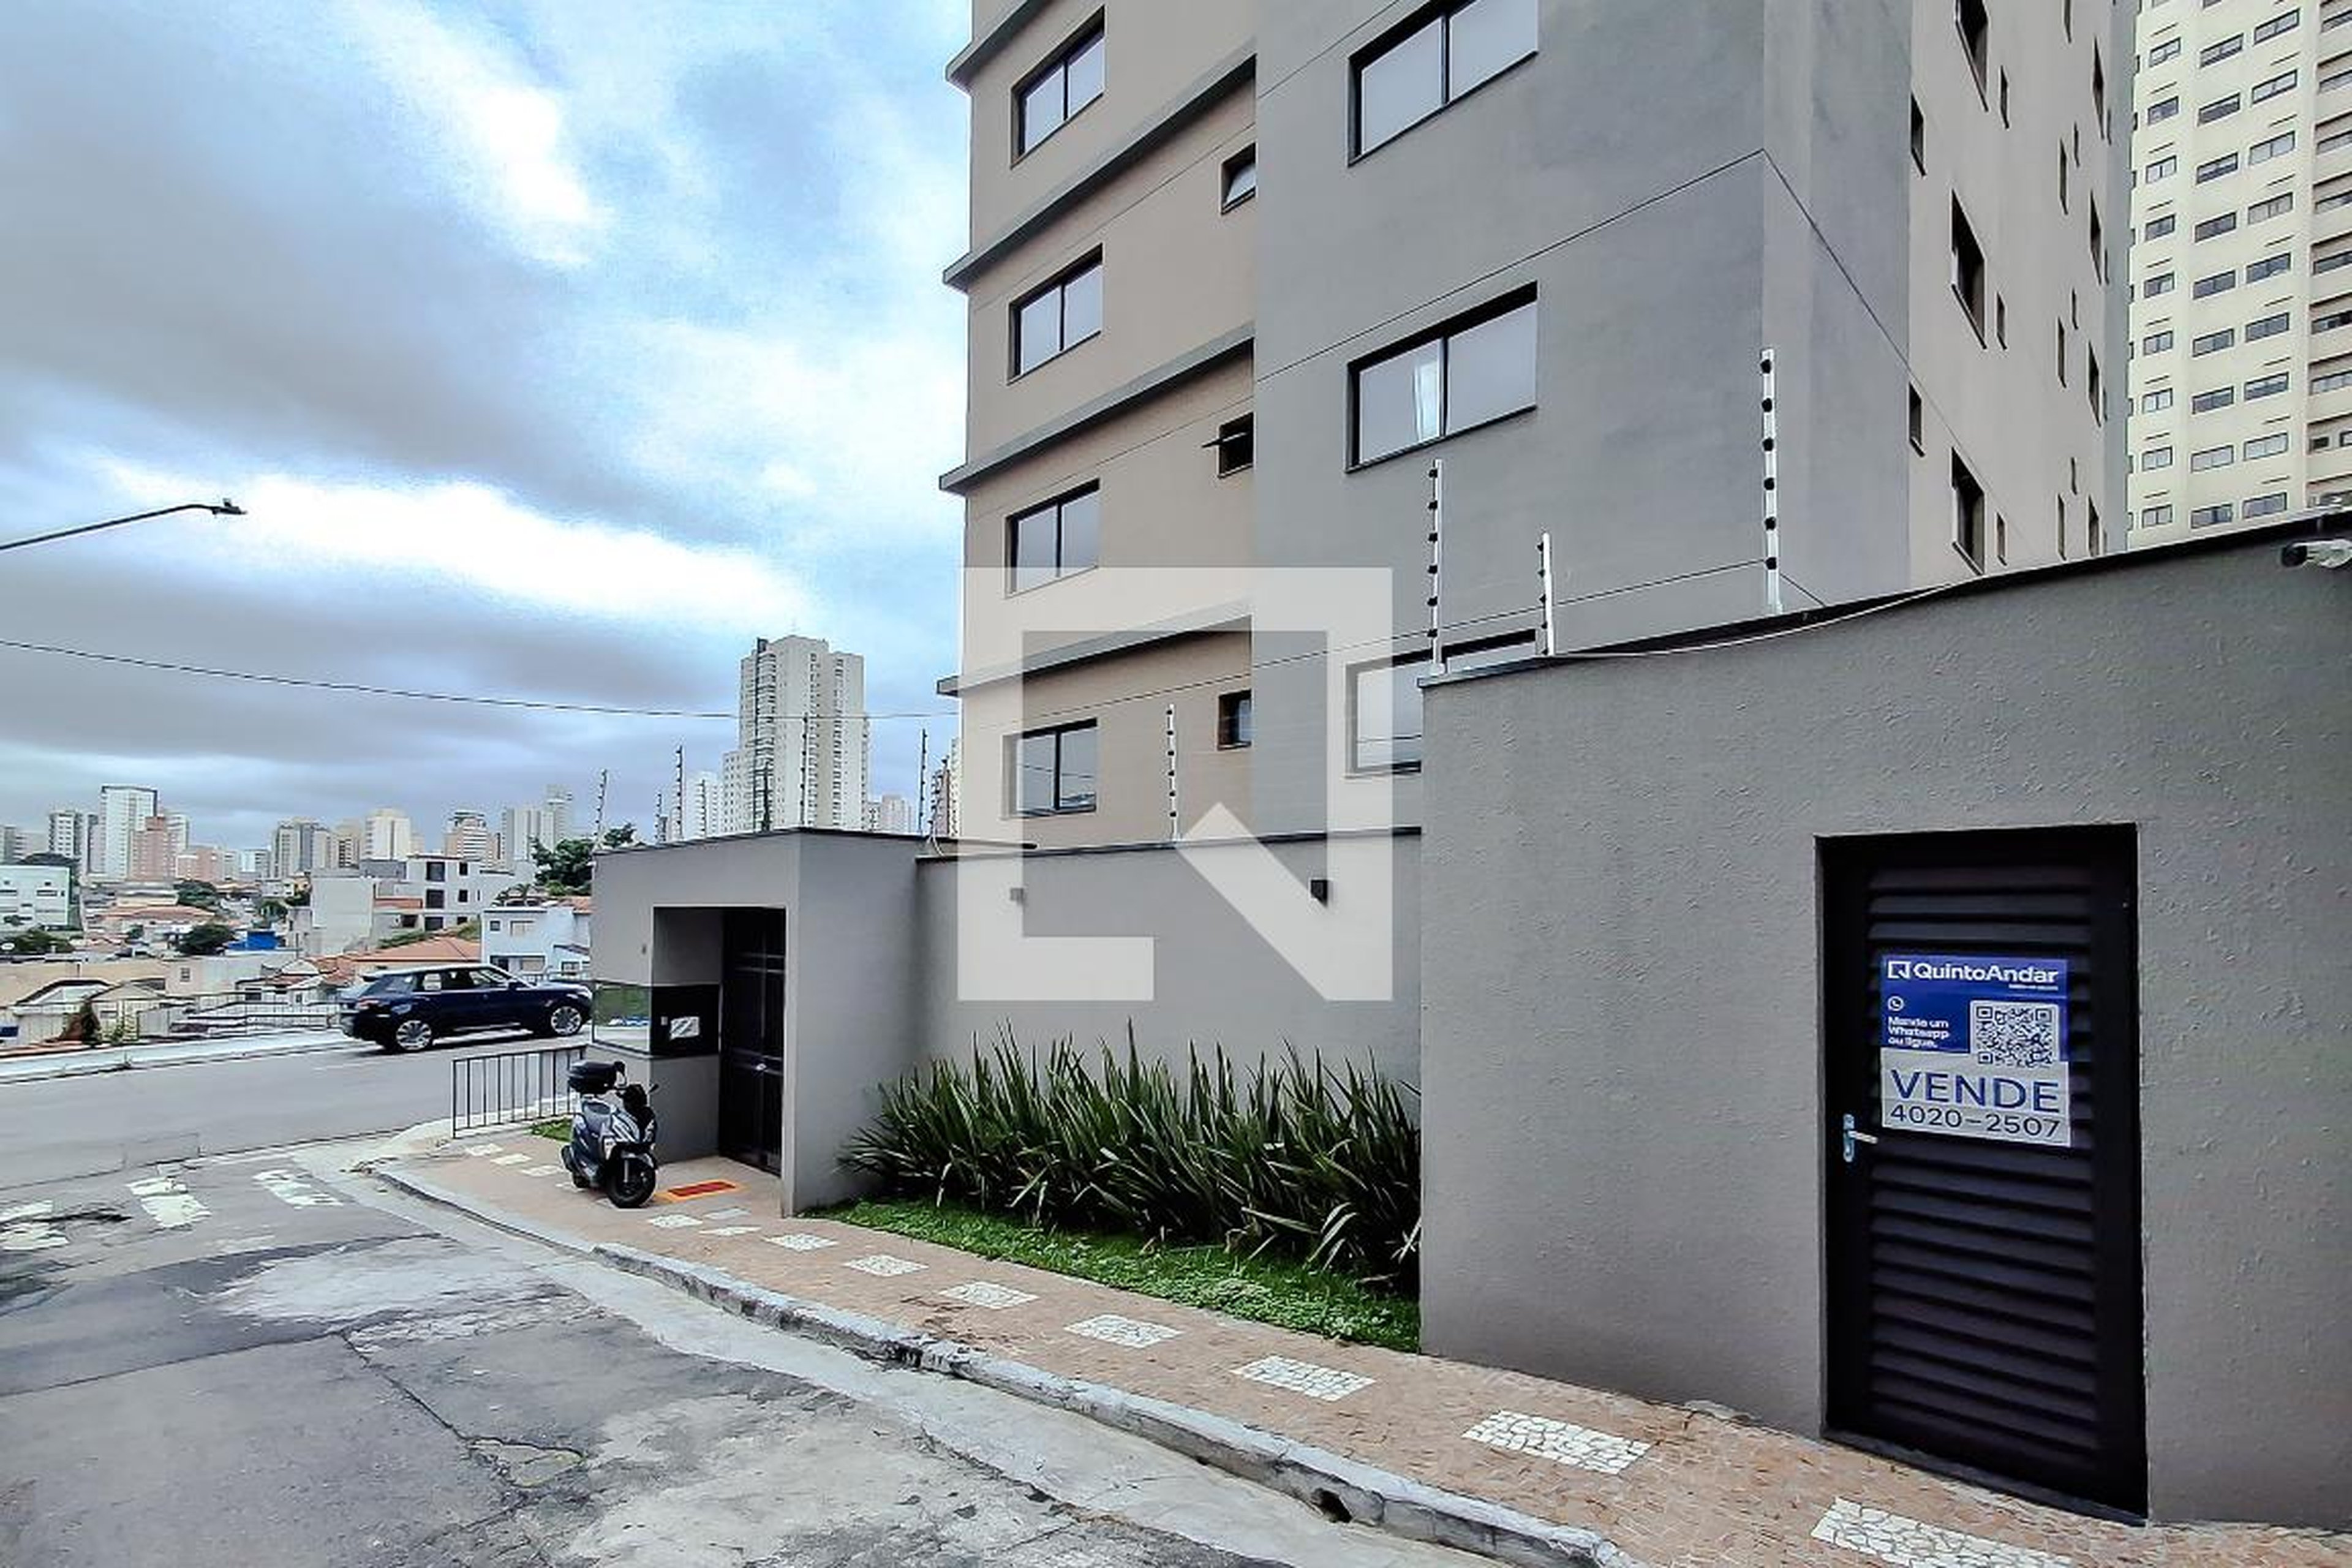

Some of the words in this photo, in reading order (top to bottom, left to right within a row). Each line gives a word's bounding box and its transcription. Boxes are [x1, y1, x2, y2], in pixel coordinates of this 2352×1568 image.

[1913, 962, 2059, 983] QuintoAndar
[1891, 1069, 2060, 1113] VENDE
[1890, 1104, 2060, 1137] 4020-2507
